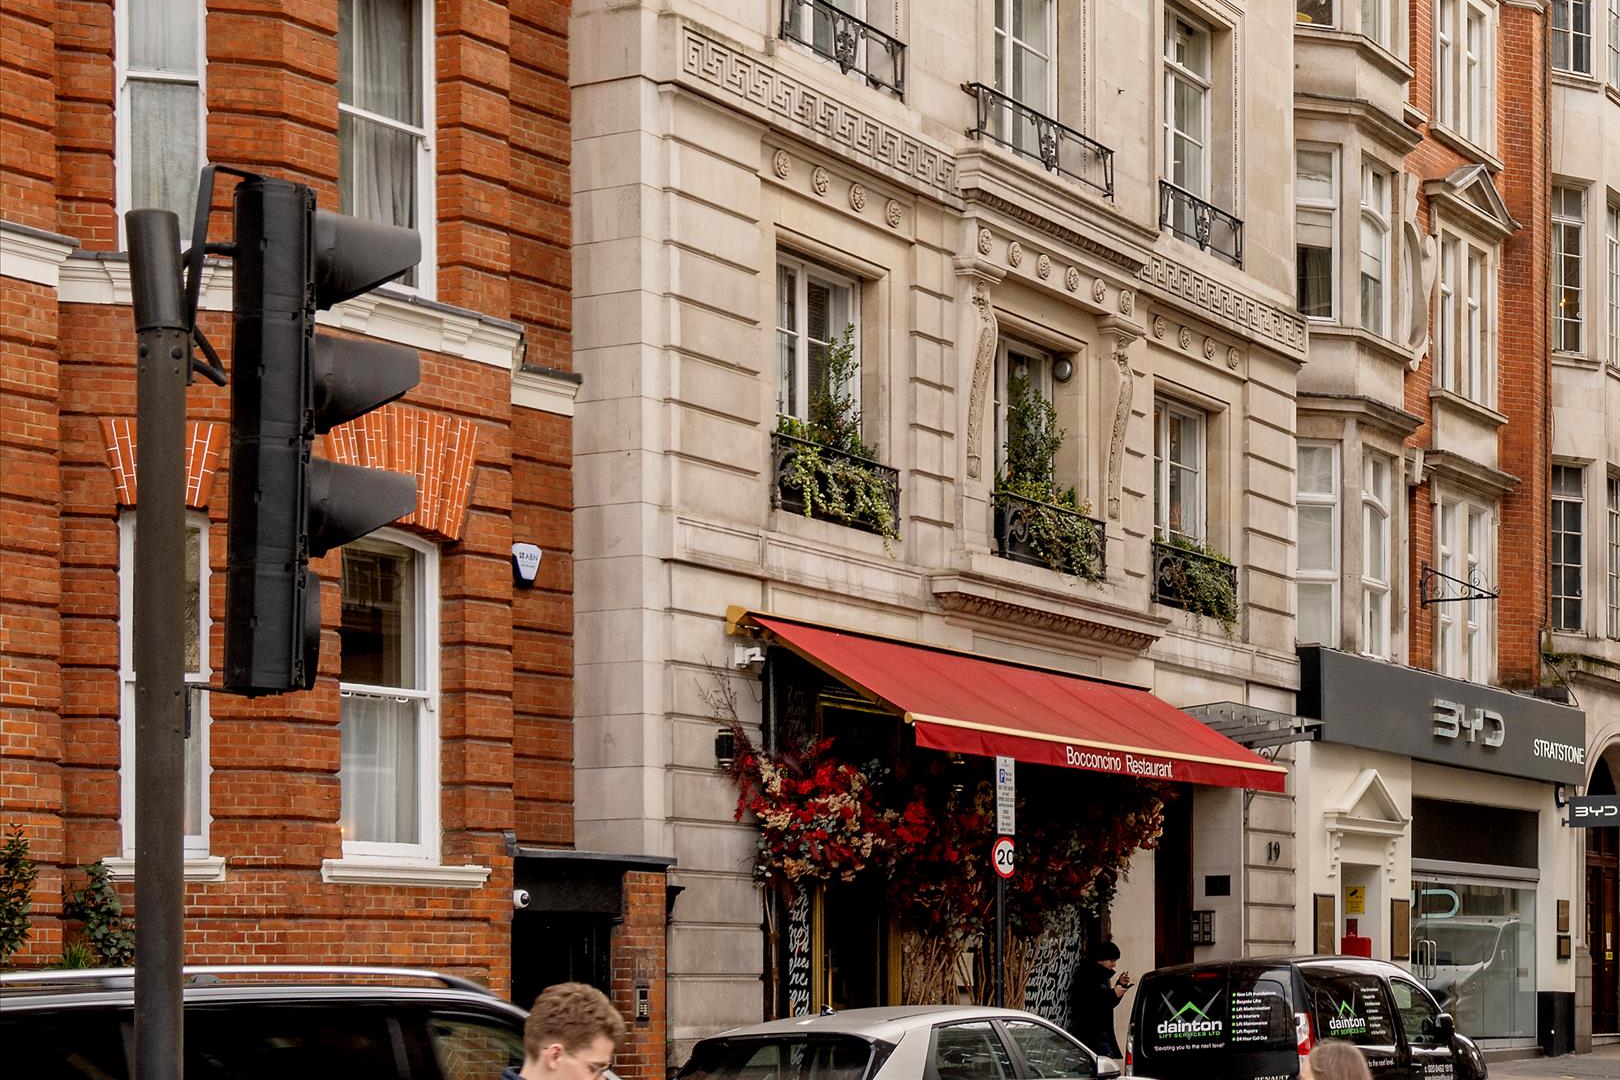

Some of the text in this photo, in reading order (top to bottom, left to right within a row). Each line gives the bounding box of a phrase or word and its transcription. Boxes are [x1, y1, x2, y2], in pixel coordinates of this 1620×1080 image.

[1433, 698, 1505, 747] BYD
[1534, 738, 1585, 765] STRATSTONE
[1066, 745, 1173, 778] Bocconcino Restaurant
[1575, 805, 1618, 817] BYD
[997, 849, 1014, 865] 20
[1267, 841, 1280, 862] 19
[1157, 1020, 1222, 1034] dainton
[1329, 1016, 1366, 1029] dainton
